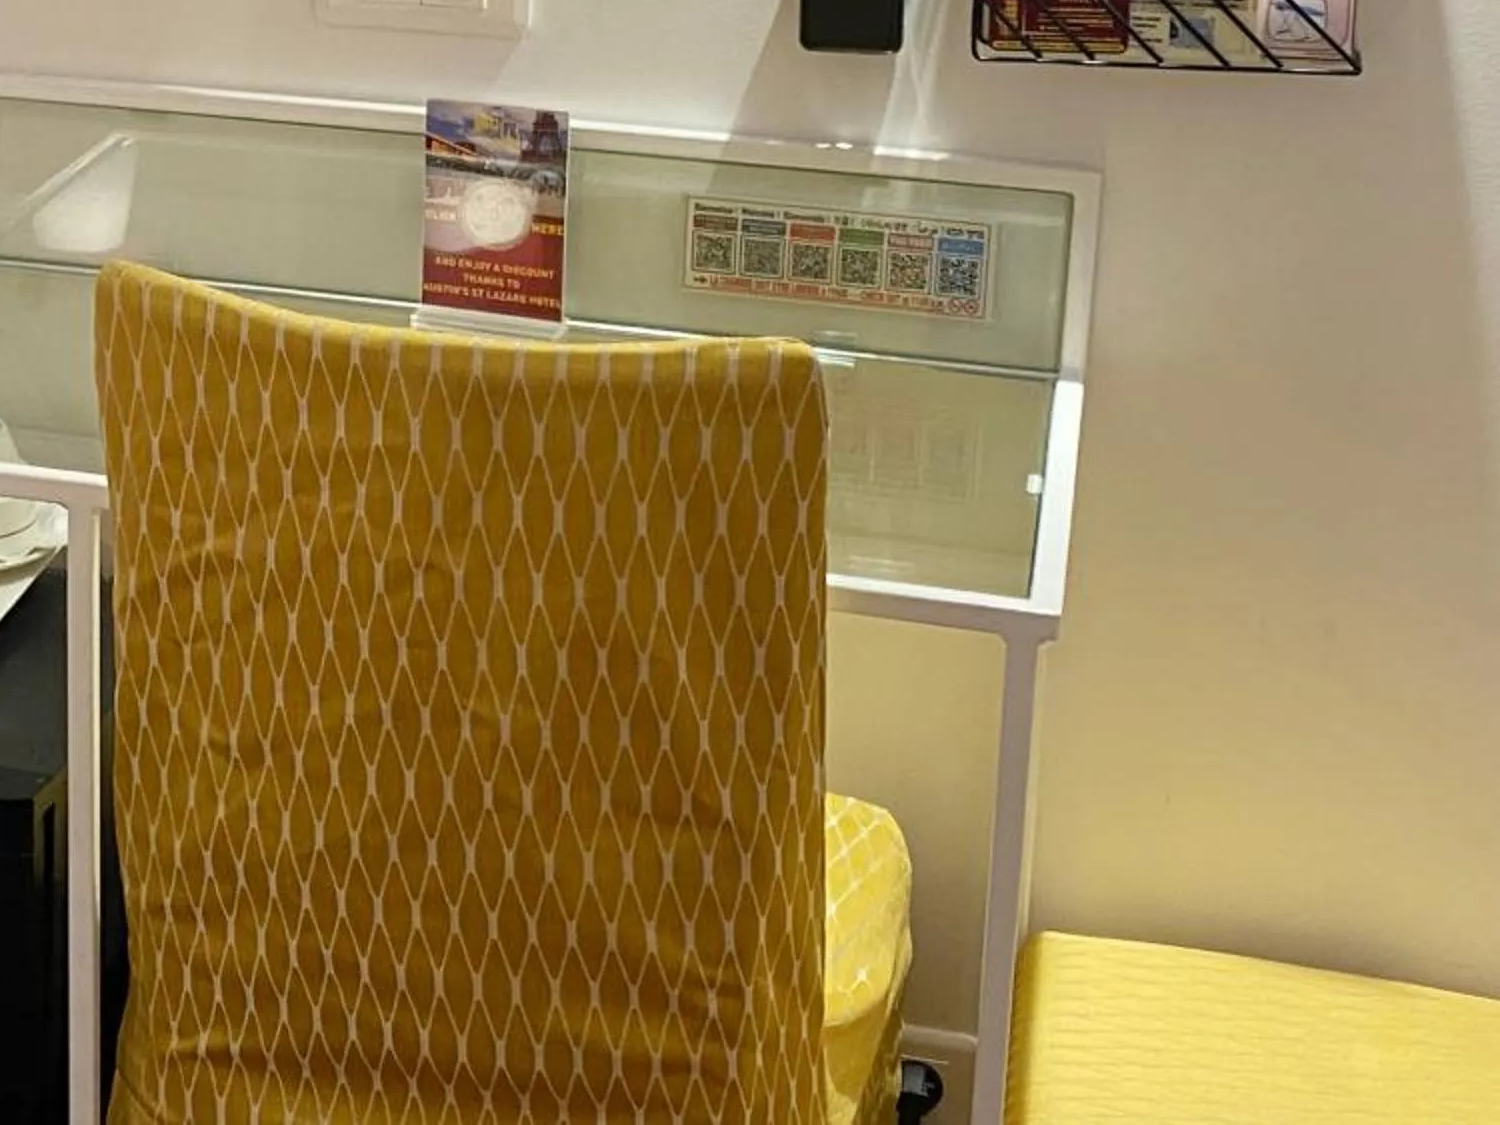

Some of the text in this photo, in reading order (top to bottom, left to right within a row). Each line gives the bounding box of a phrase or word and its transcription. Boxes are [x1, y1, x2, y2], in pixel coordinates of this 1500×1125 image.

[435, 255, 457, 268] AND
[458, 258, 492, 272] ENJOY
[501, 264, 555, 280] DISCOUNT
[463, 272, 521, 289] THANKS TO
